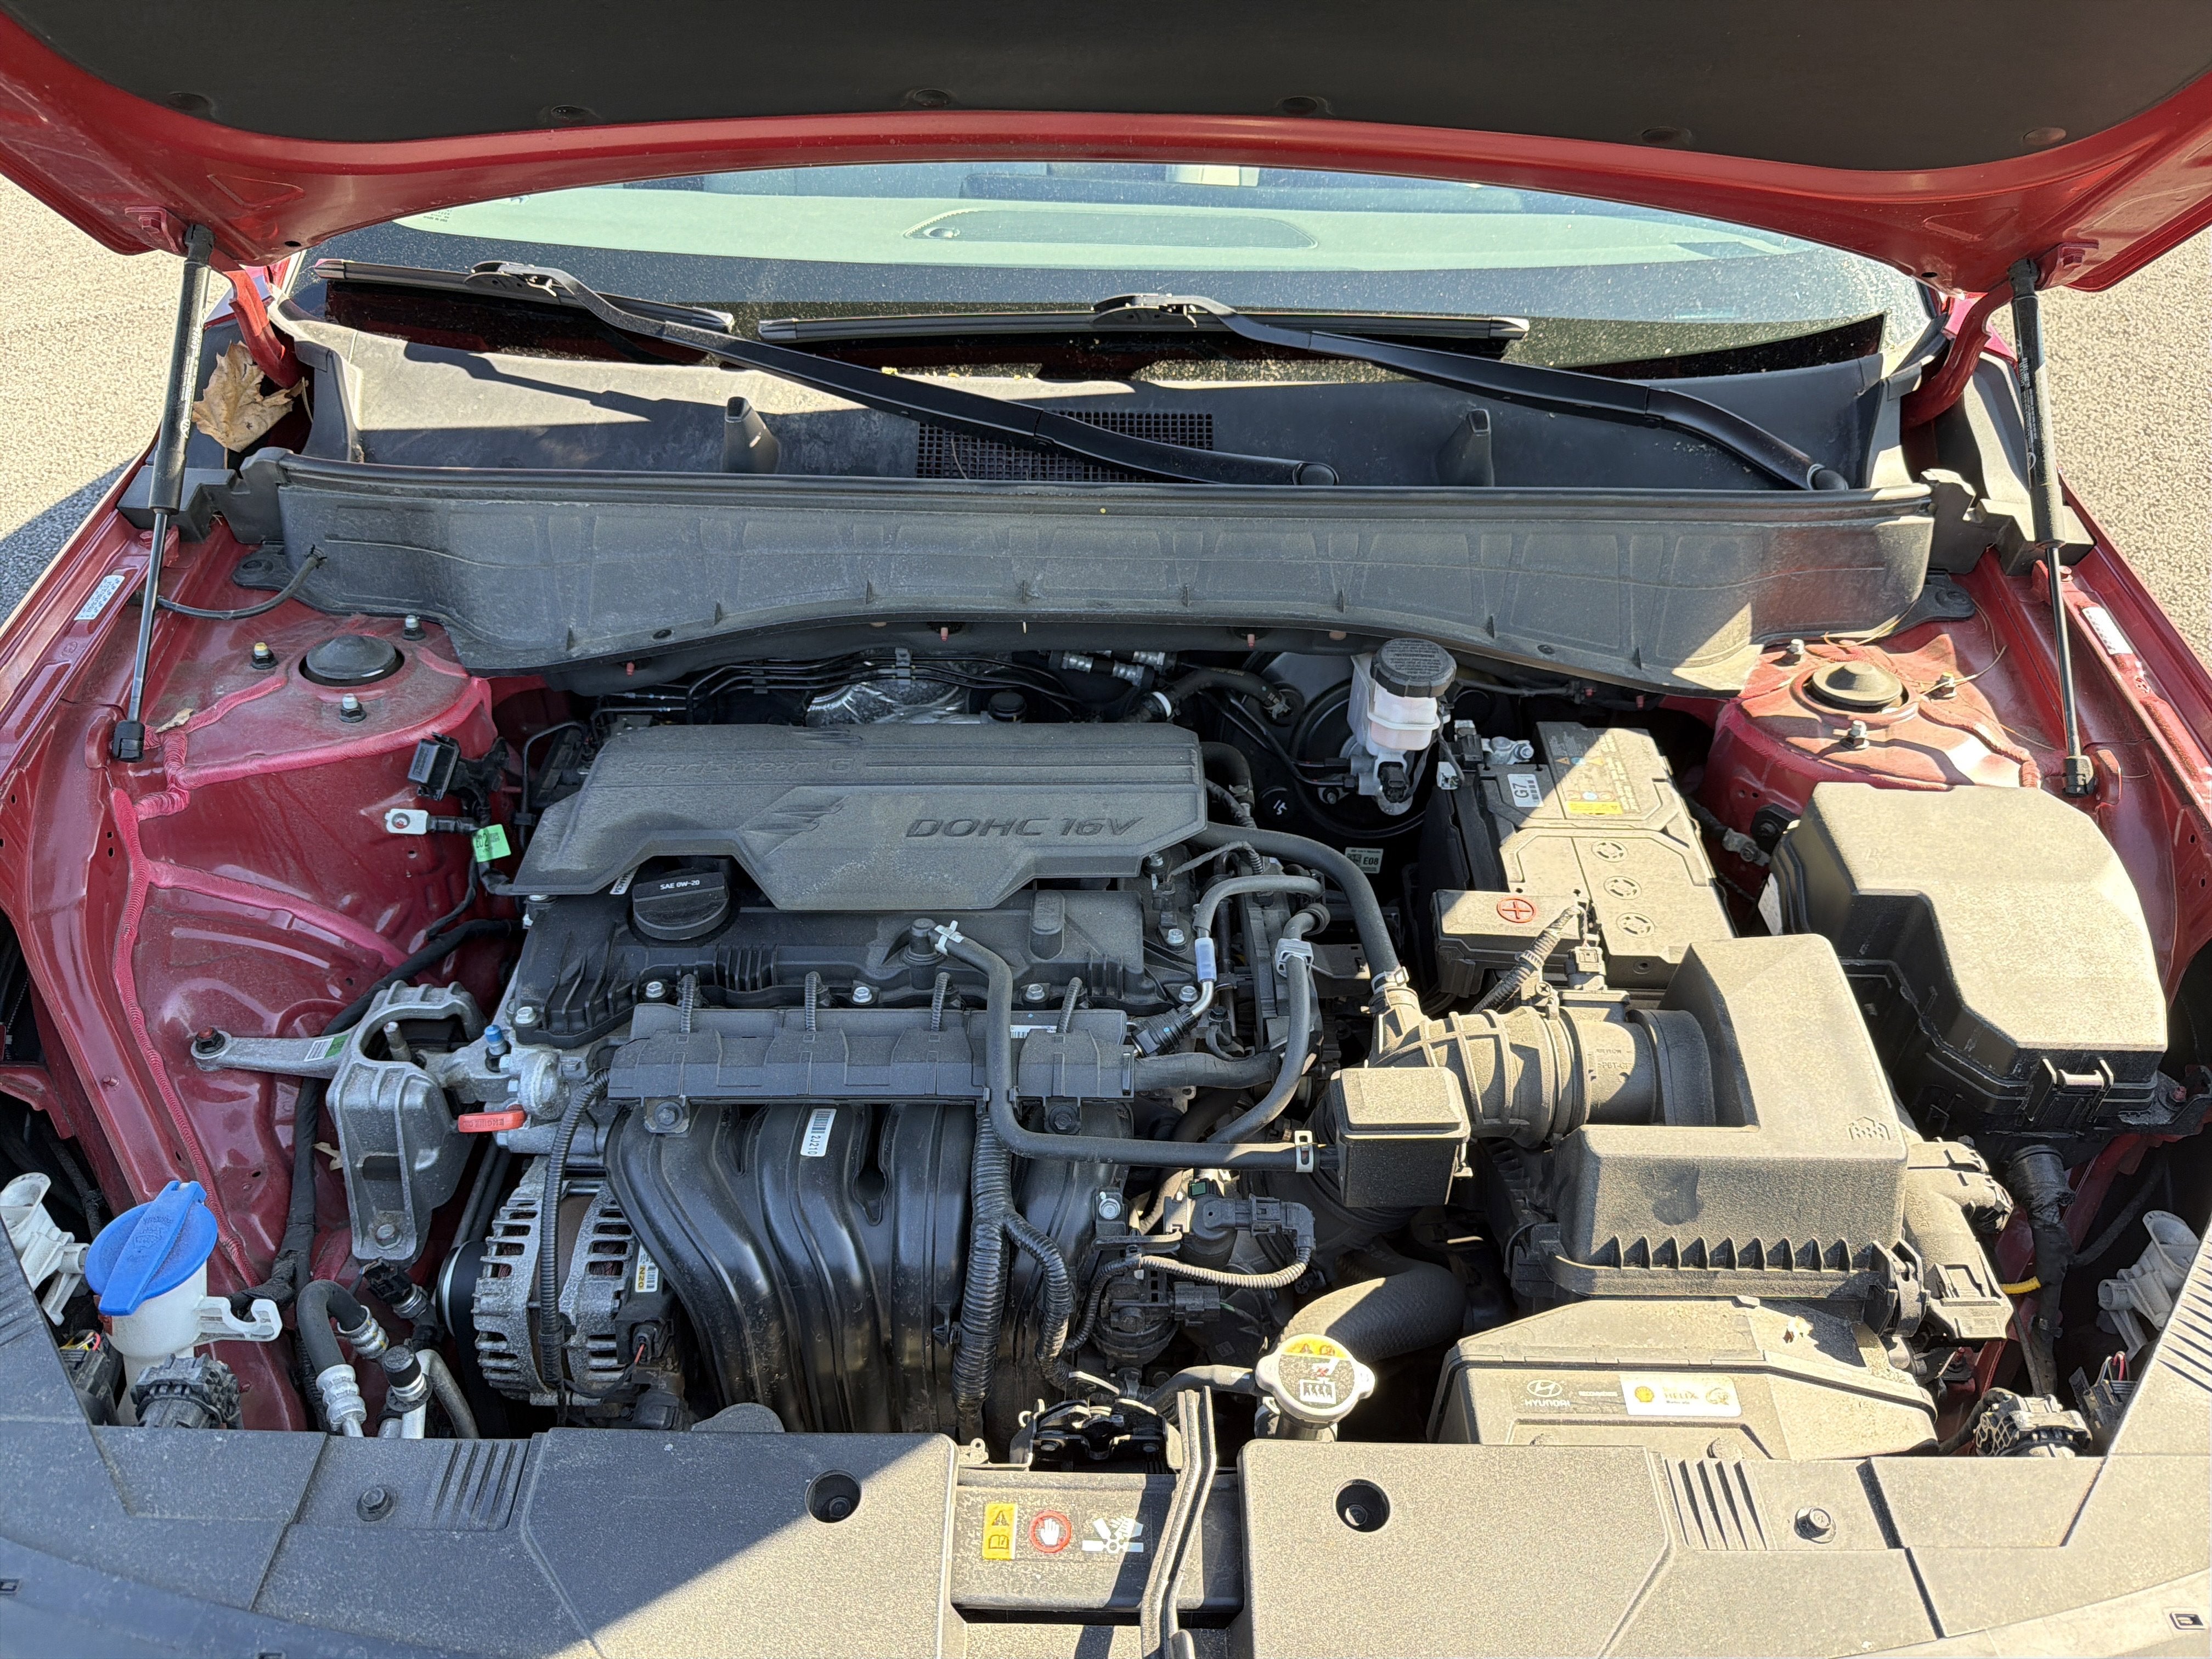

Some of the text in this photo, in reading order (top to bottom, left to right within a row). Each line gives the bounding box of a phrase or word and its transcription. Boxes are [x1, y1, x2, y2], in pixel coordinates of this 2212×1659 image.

[1513, 782, 1530, 798] G7
[906, 816, 1144, 838] DOHC 16V
[476, 832, 489, 849] E02
[1363, 856, 1379, 866] E08
[659, 879, 701, 890] SAE 0W-20
[475, 1118, 505, 1128] ENGINE
[807, 1135, 821, 1155] 2J210
[1524, 1399, 1571, 1407] HYUNDAI
